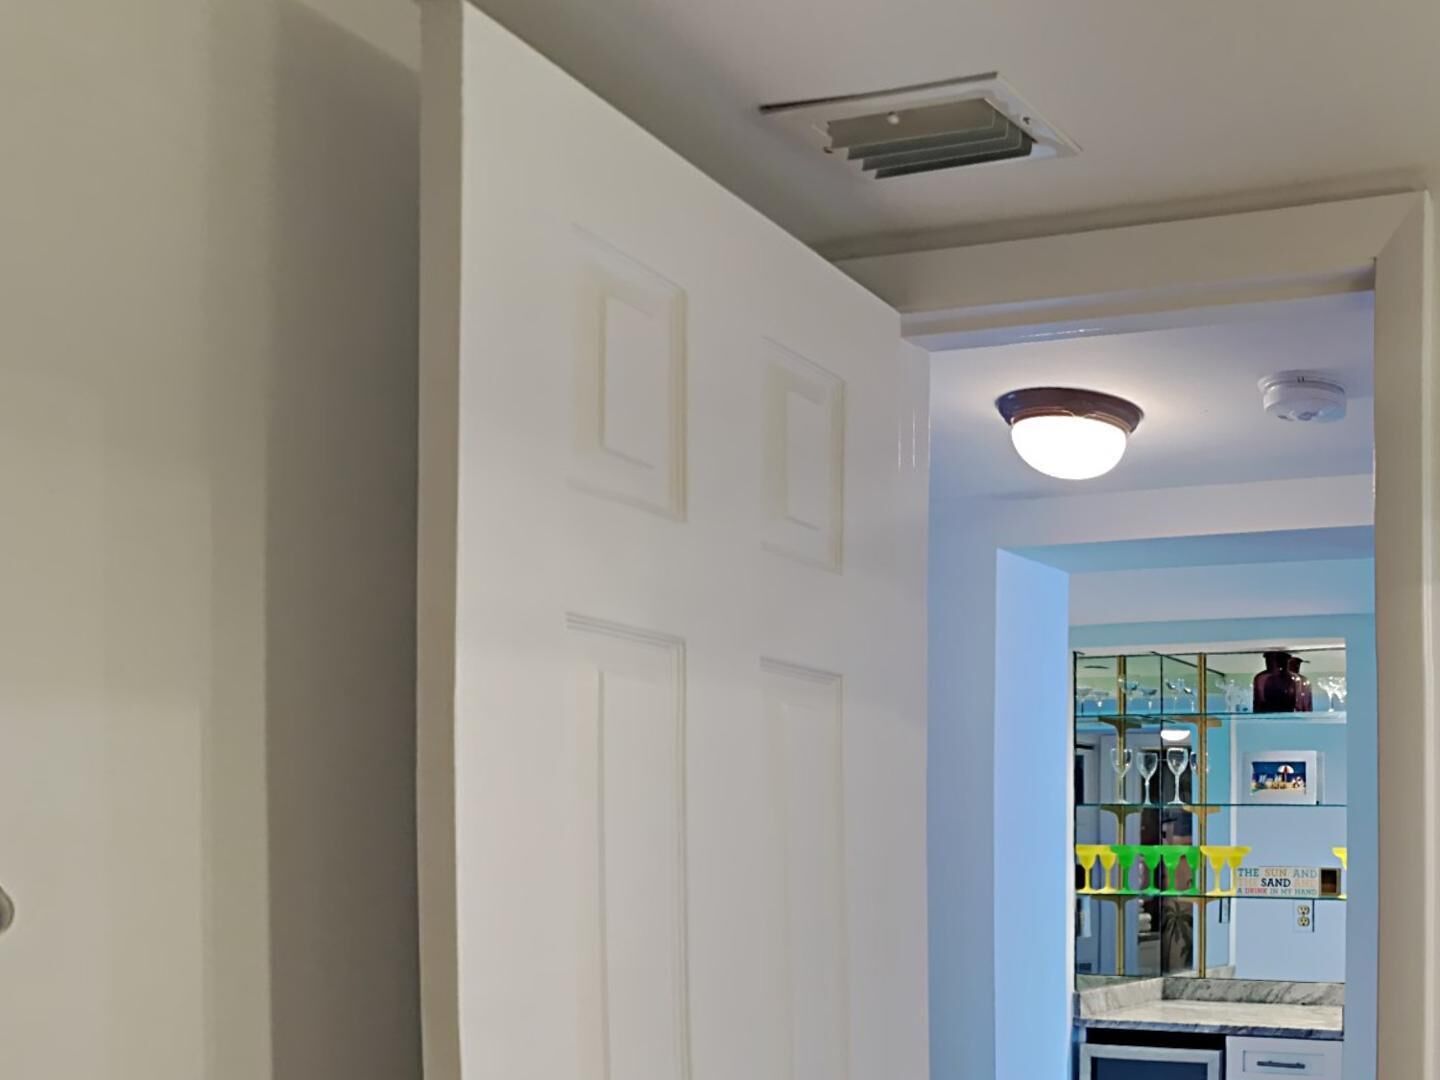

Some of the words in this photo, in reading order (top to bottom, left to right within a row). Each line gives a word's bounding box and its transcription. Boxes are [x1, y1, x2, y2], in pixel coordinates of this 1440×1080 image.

[1237, 868, 1259, 877] THE
[1264, 868, 1287, 877] SUN
[1293, 869, 1317, 878] AND
[1260, 877, 1291, 887] SAND
